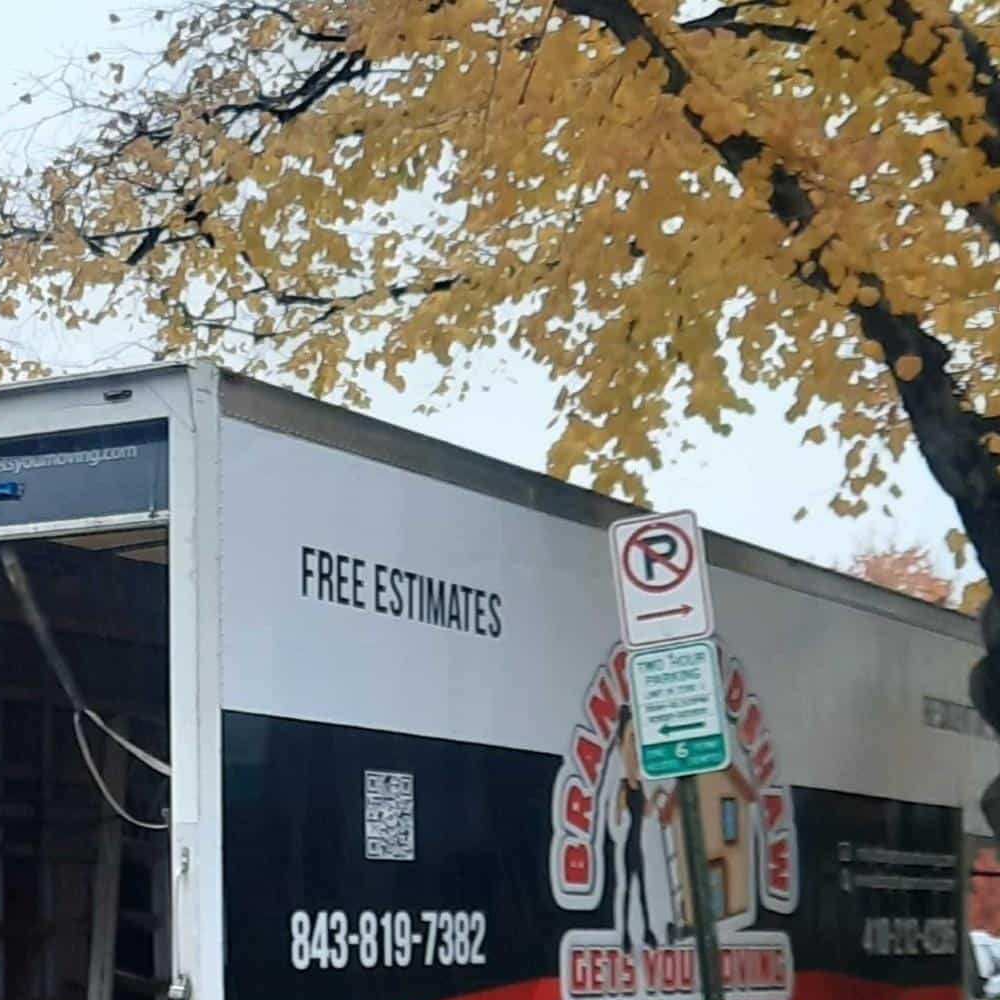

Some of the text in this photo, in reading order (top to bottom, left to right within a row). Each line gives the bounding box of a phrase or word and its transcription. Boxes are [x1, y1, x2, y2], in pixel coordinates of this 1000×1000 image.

[302, 546, 502, 638] FREE ESTIMATES
[290, 910, 486, 970] 843-819-7382
[571, 949, 787, 993] GETS YOU OVING
